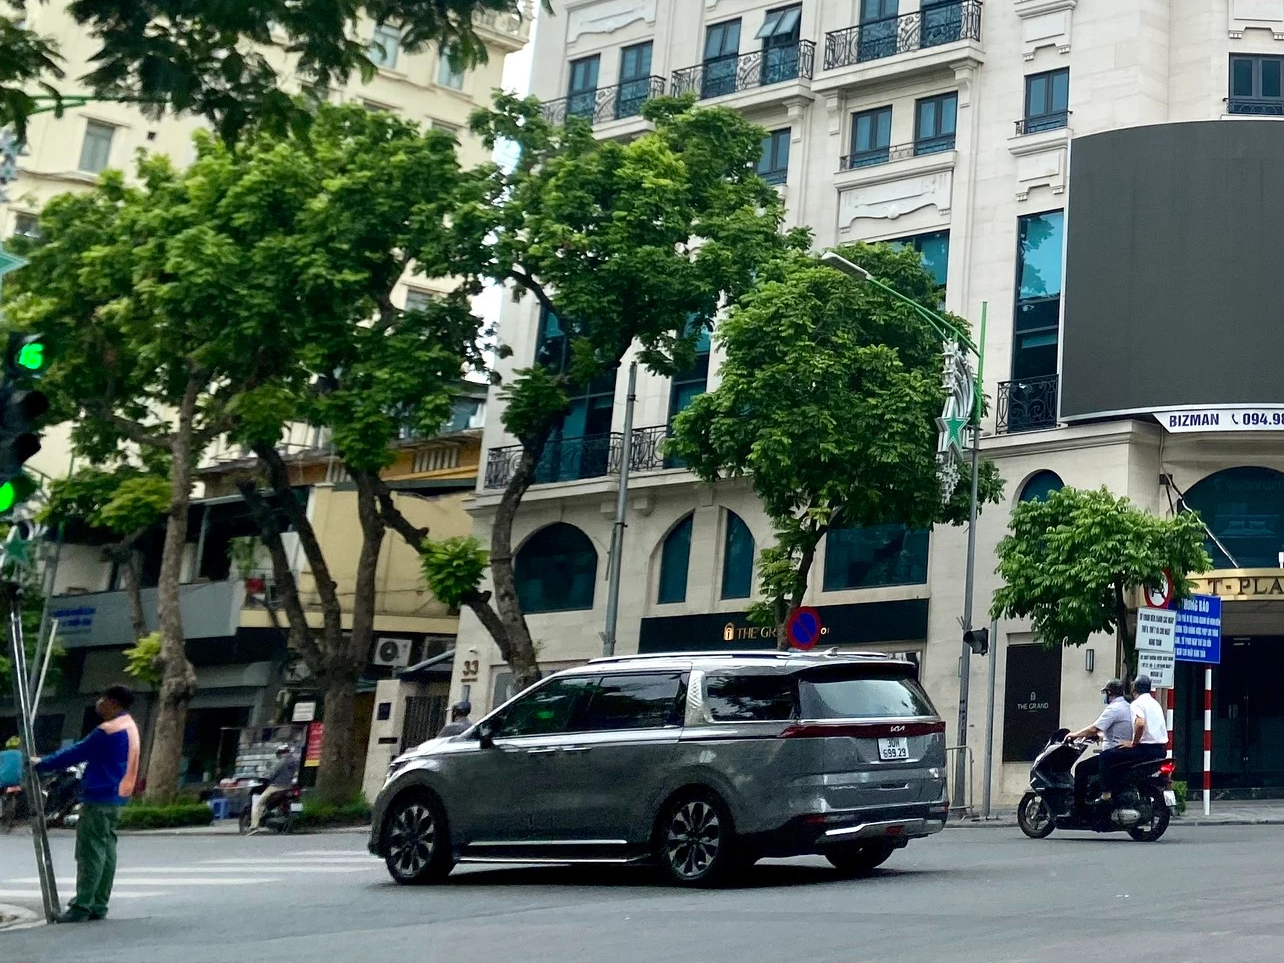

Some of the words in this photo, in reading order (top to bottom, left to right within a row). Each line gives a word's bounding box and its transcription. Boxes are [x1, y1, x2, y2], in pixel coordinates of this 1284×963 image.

[1169, 413, 1220, 428] BIZMAN
[736, 627, 758, 639] THE
[462, 659, 479, 676] 33
[1028, 702, 1049, 710] GRAND
